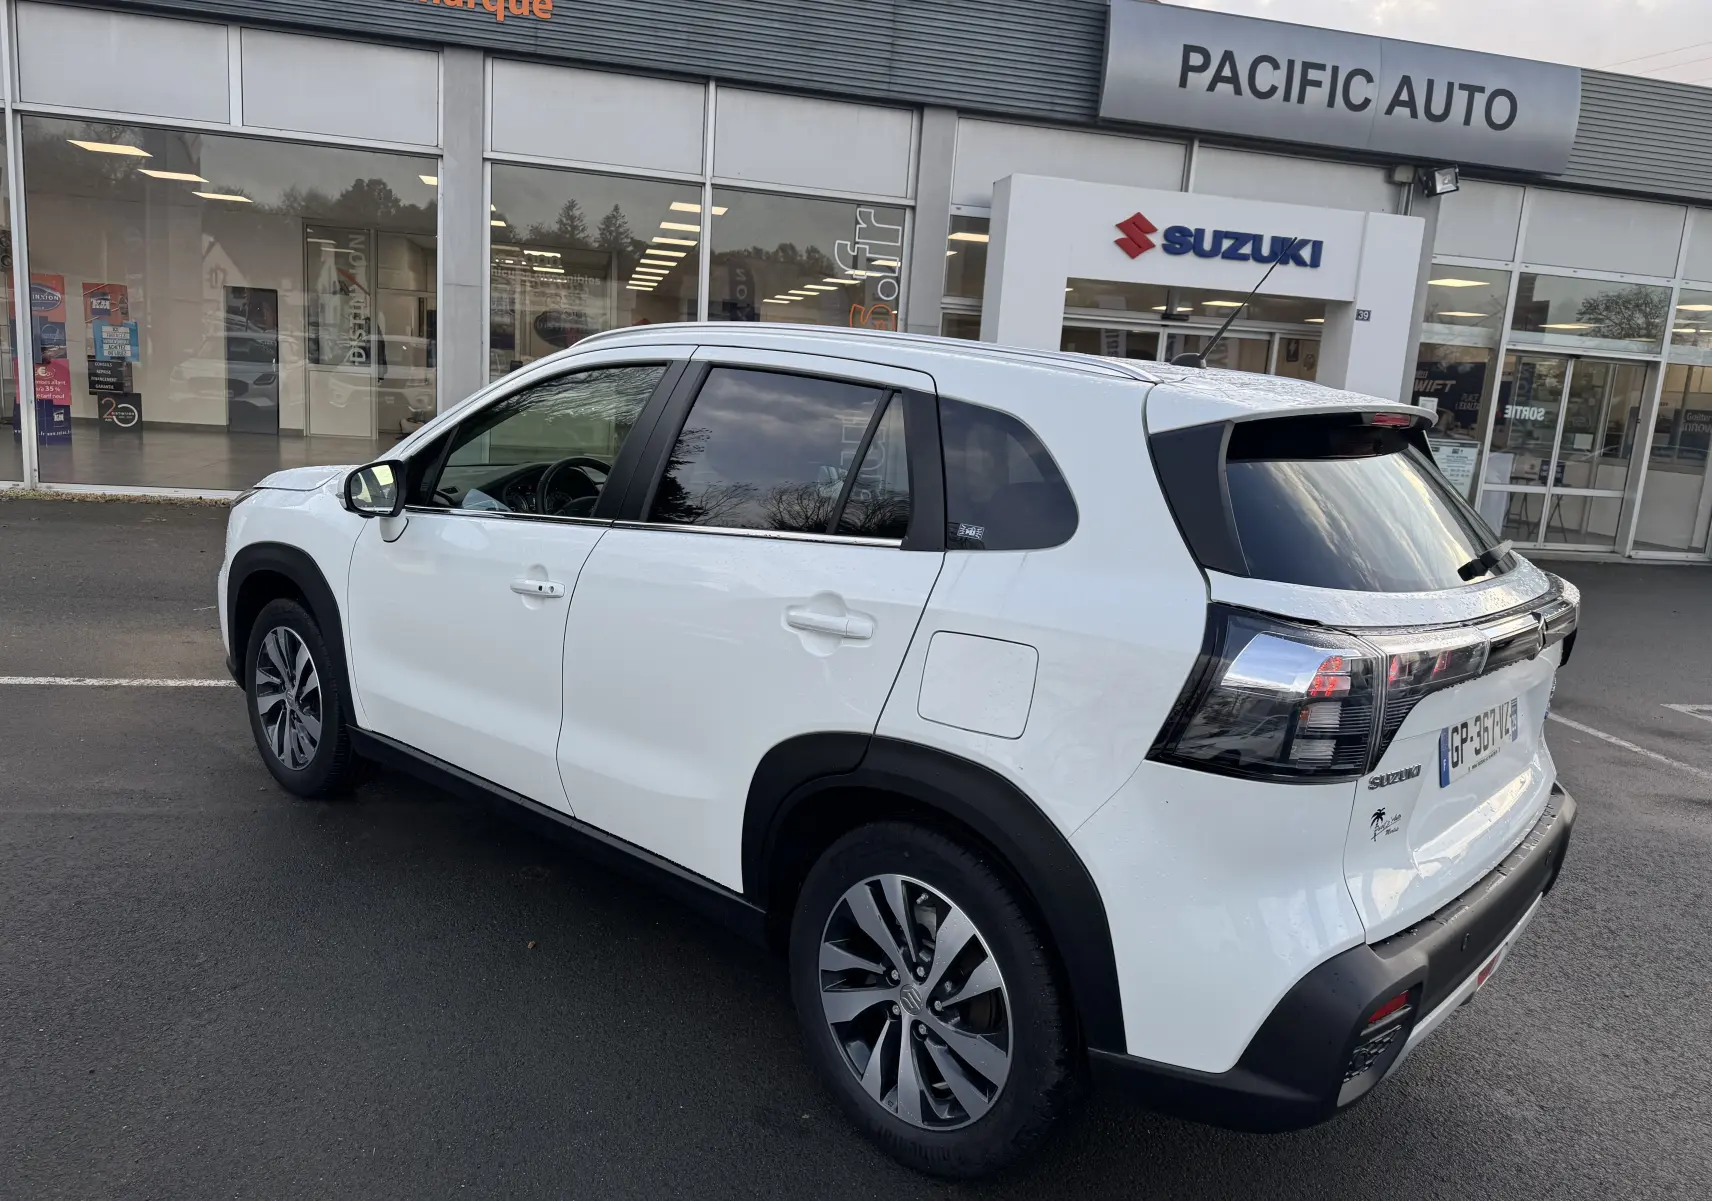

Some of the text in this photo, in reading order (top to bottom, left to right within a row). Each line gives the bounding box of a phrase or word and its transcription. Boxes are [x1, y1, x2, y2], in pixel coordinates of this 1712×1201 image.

[1178, 44, 1518, 131] PACIFIC AUTO
[1161, 225, 1323, 268] SUZUKI
[1357, 310, 1369, 320] 39
[1451, 701, 1509, 769] GP-367-VZ
[1368, 764, 1421, 790] SUZUKI
